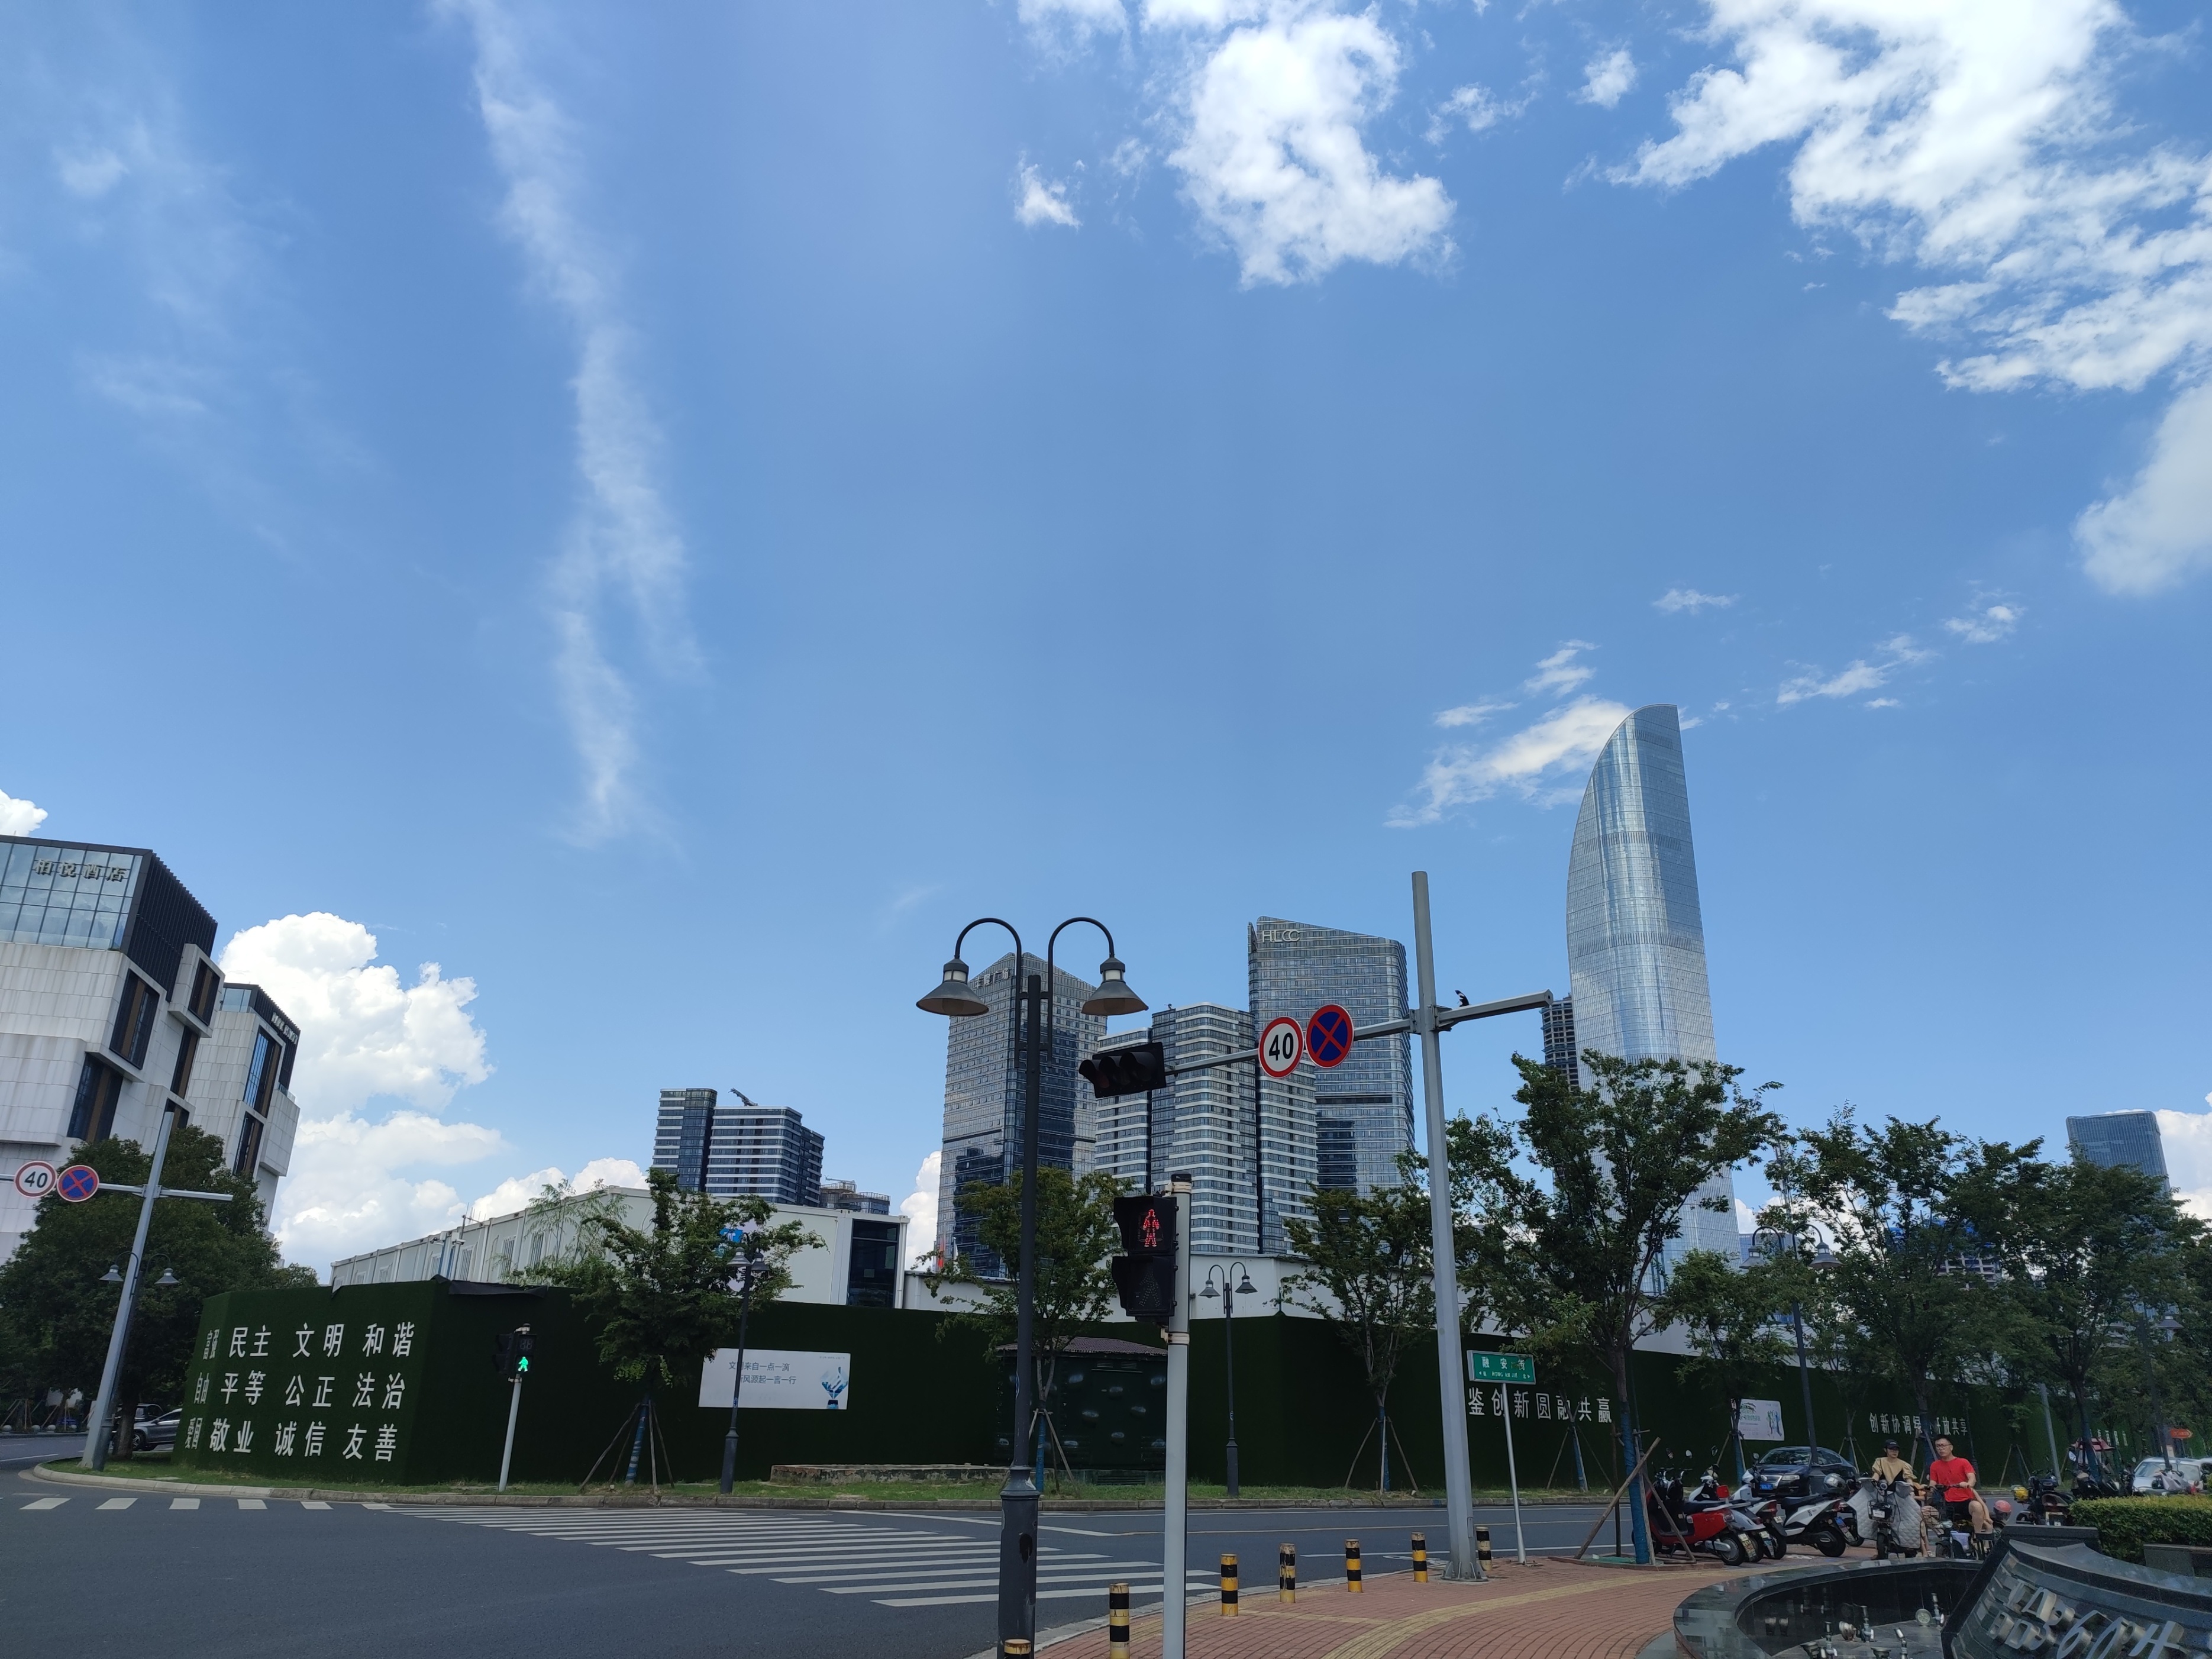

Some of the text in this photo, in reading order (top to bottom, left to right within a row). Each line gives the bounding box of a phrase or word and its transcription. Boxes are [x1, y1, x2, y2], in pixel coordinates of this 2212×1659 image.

[35, 859, 127, 882] 柏悦酒店
[1262, 929, 1300, 943] HLCC
[1268, 1032, 1294, 1061] 40
[24, 1171, 48, 1188] 40
[202, 1321, 415, 1360] 富强 民主 文明 和谐
[728, 1361, 790, 1372] 文来自一点一滴
[193, 1369, 405, 1409] 自由 平等 公正 法治
[209, 1418, 254, 1453] 敬业
[274, 1421, 327, 1457] 诚信
[343, 1423, 398, 1462] 友善
